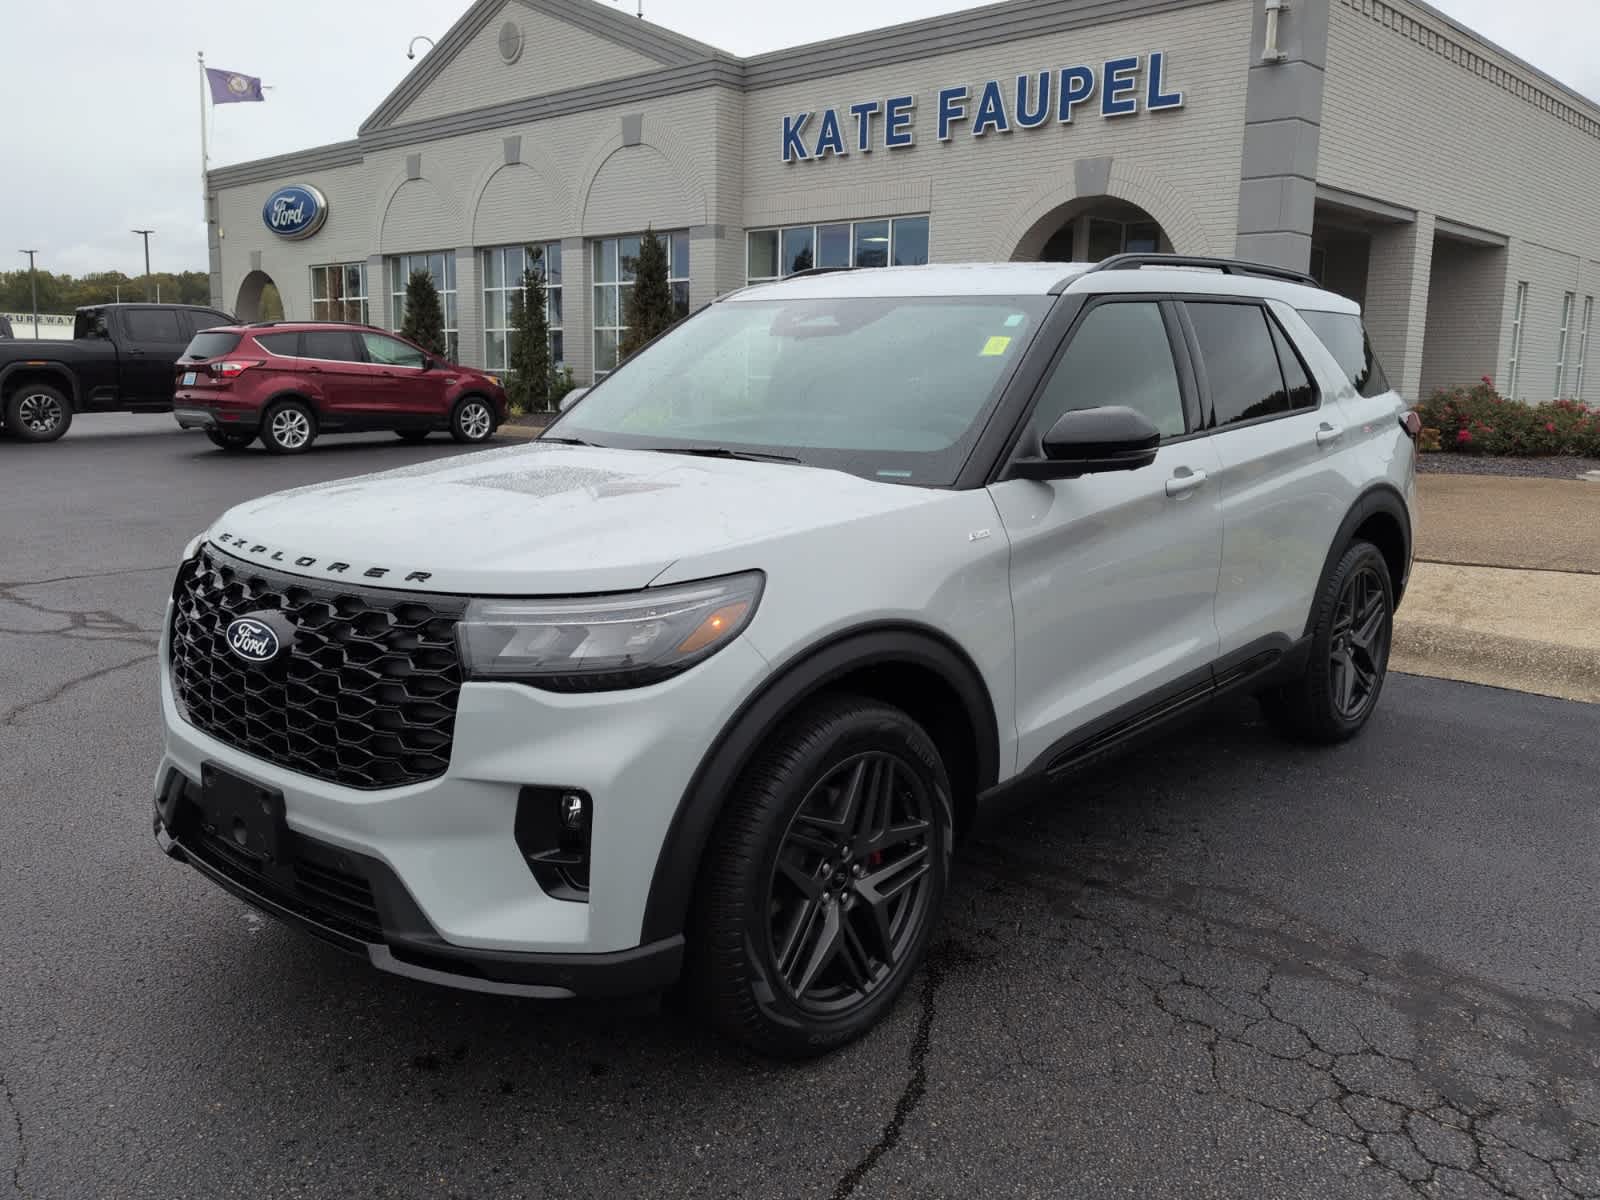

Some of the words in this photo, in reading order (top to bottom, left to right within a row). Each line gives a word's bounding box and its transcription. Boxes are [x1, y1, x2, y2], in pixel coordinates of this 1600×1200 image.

[781, 94, 915, 163] KATE
[936, 51, 1183, 142] FAUPEL
[271, 195, 305, 228] Ford
[218, 532, 433, 583] EXPLORER
[232, 622, 271, 657] Ford
